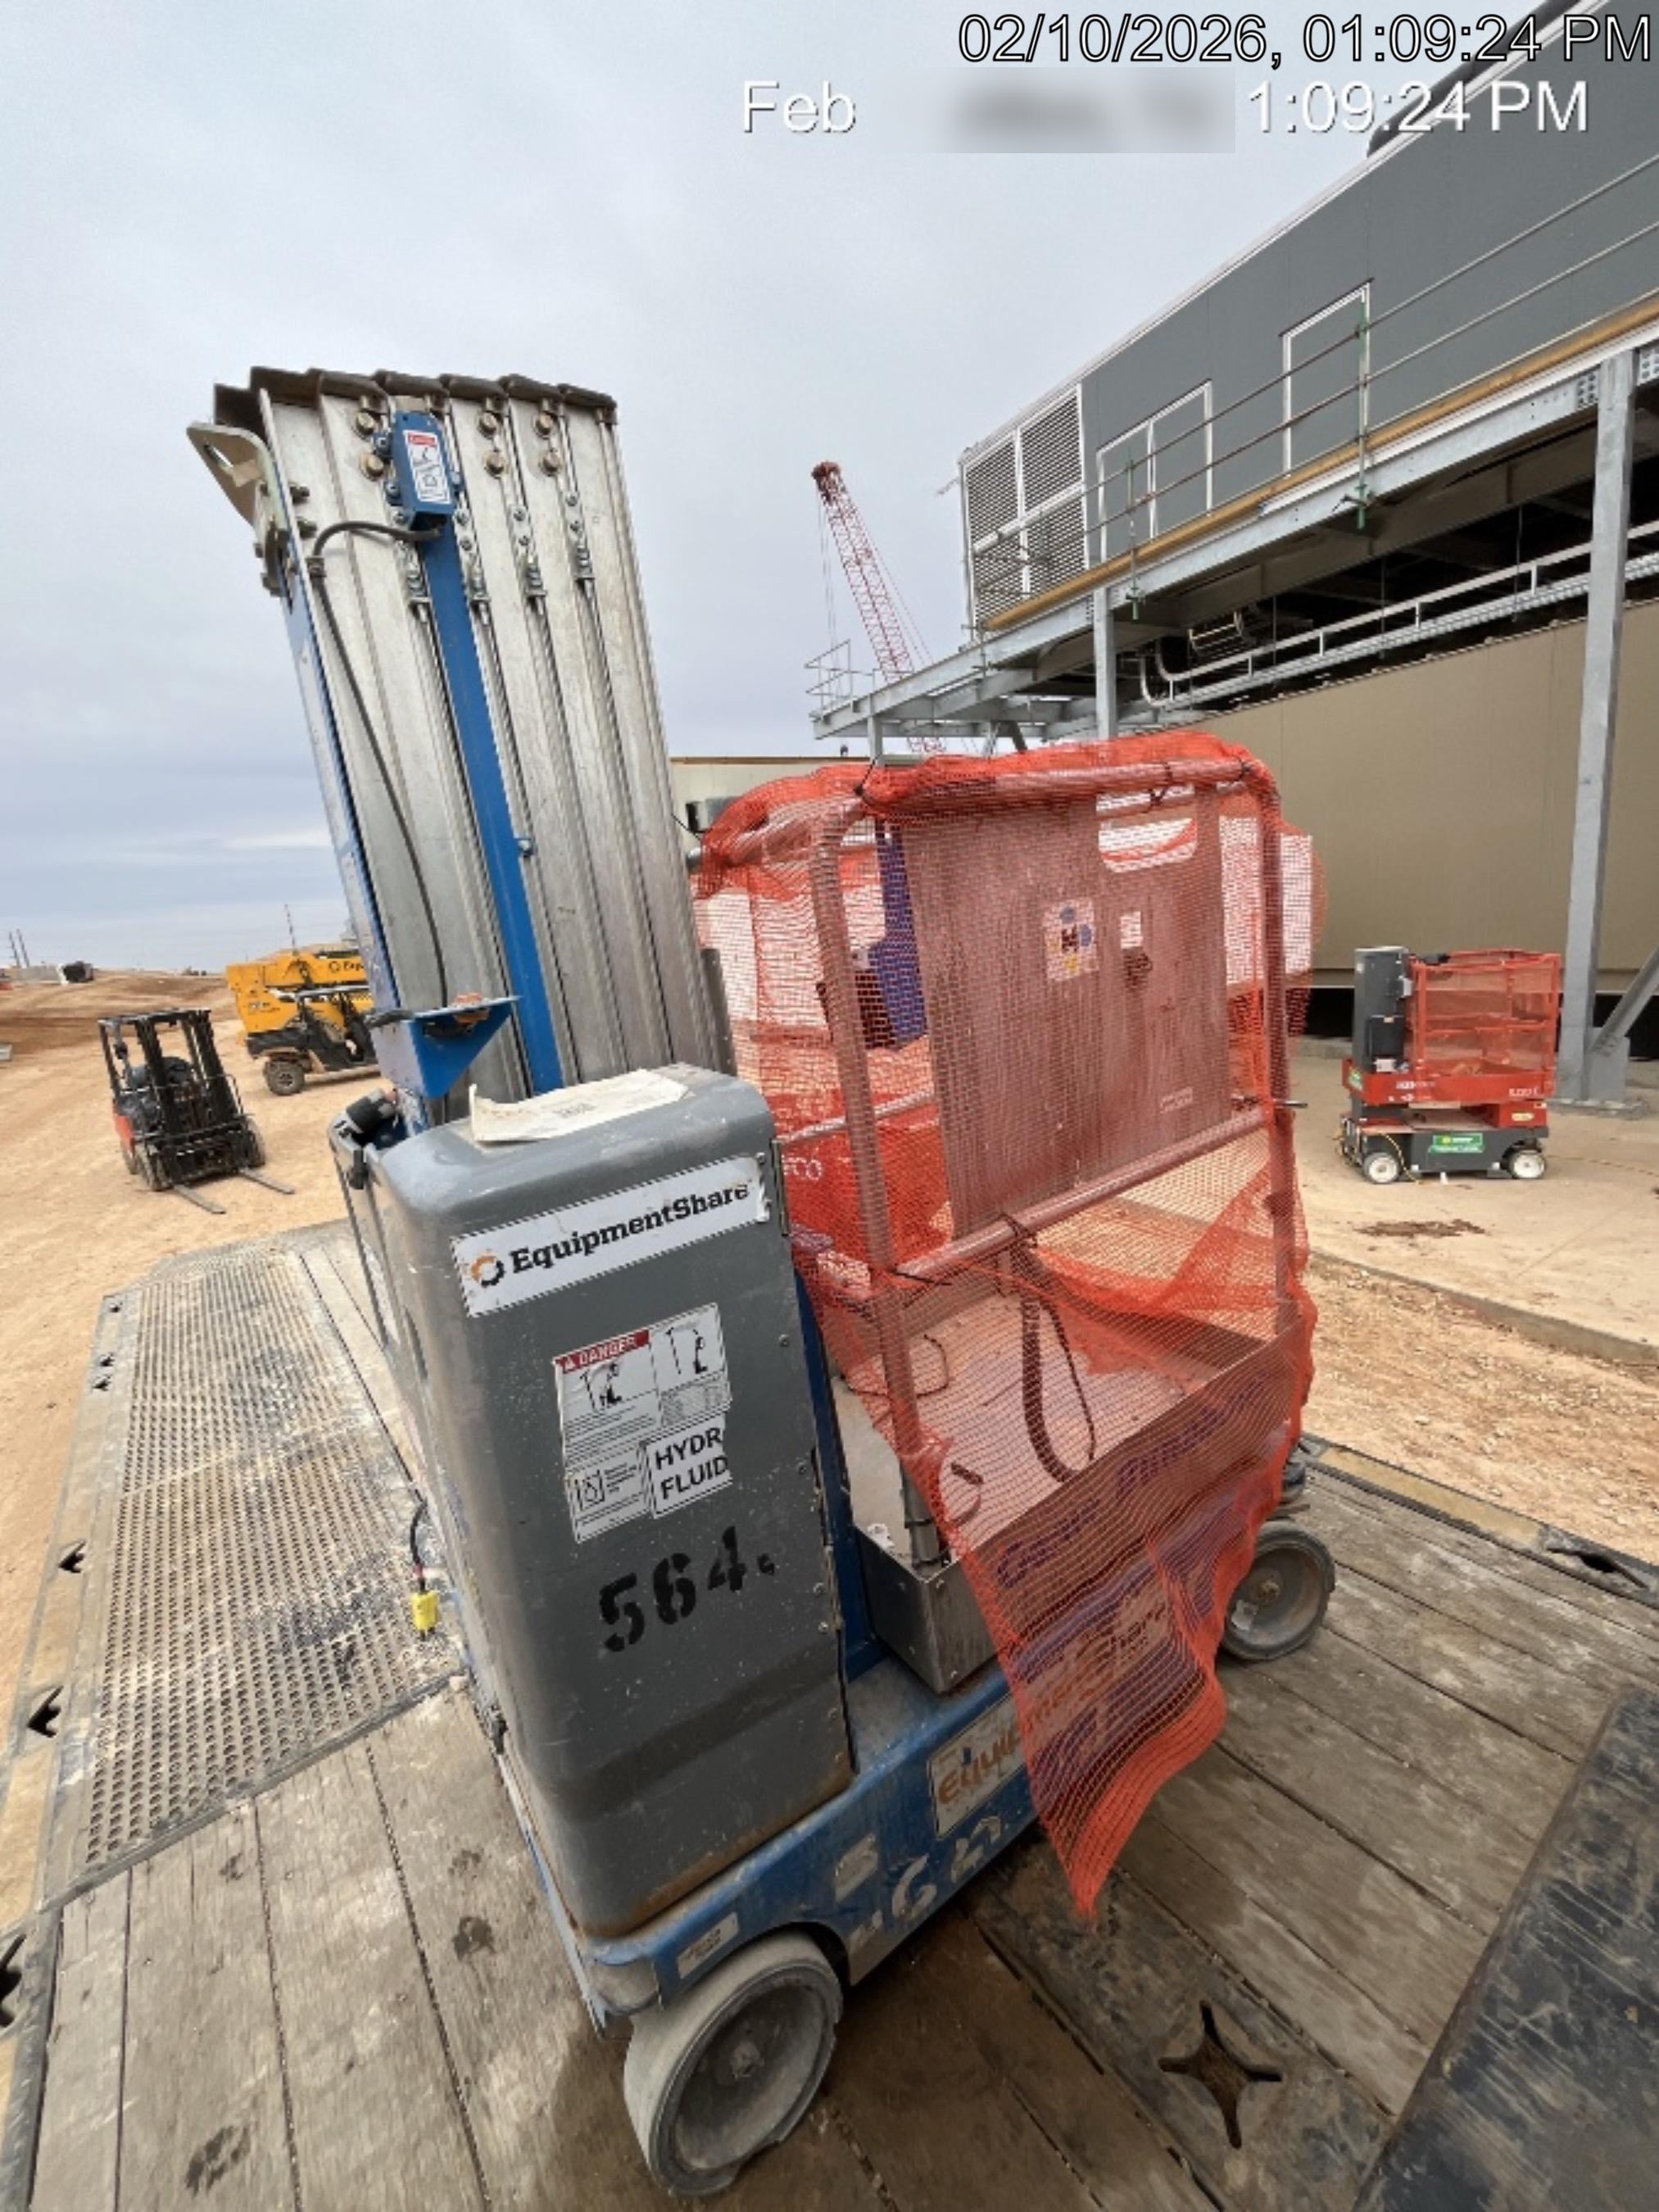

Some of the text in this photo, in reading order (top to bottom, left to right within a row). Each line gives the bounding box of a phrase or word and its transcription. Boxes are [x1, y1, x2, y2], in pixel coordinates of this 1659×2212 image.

[510, 1184, 749, 1273] EquipmentShare
[578, 1336, 637, 1367] DANGER
[660, 1457, 730, 1500] FLUID
